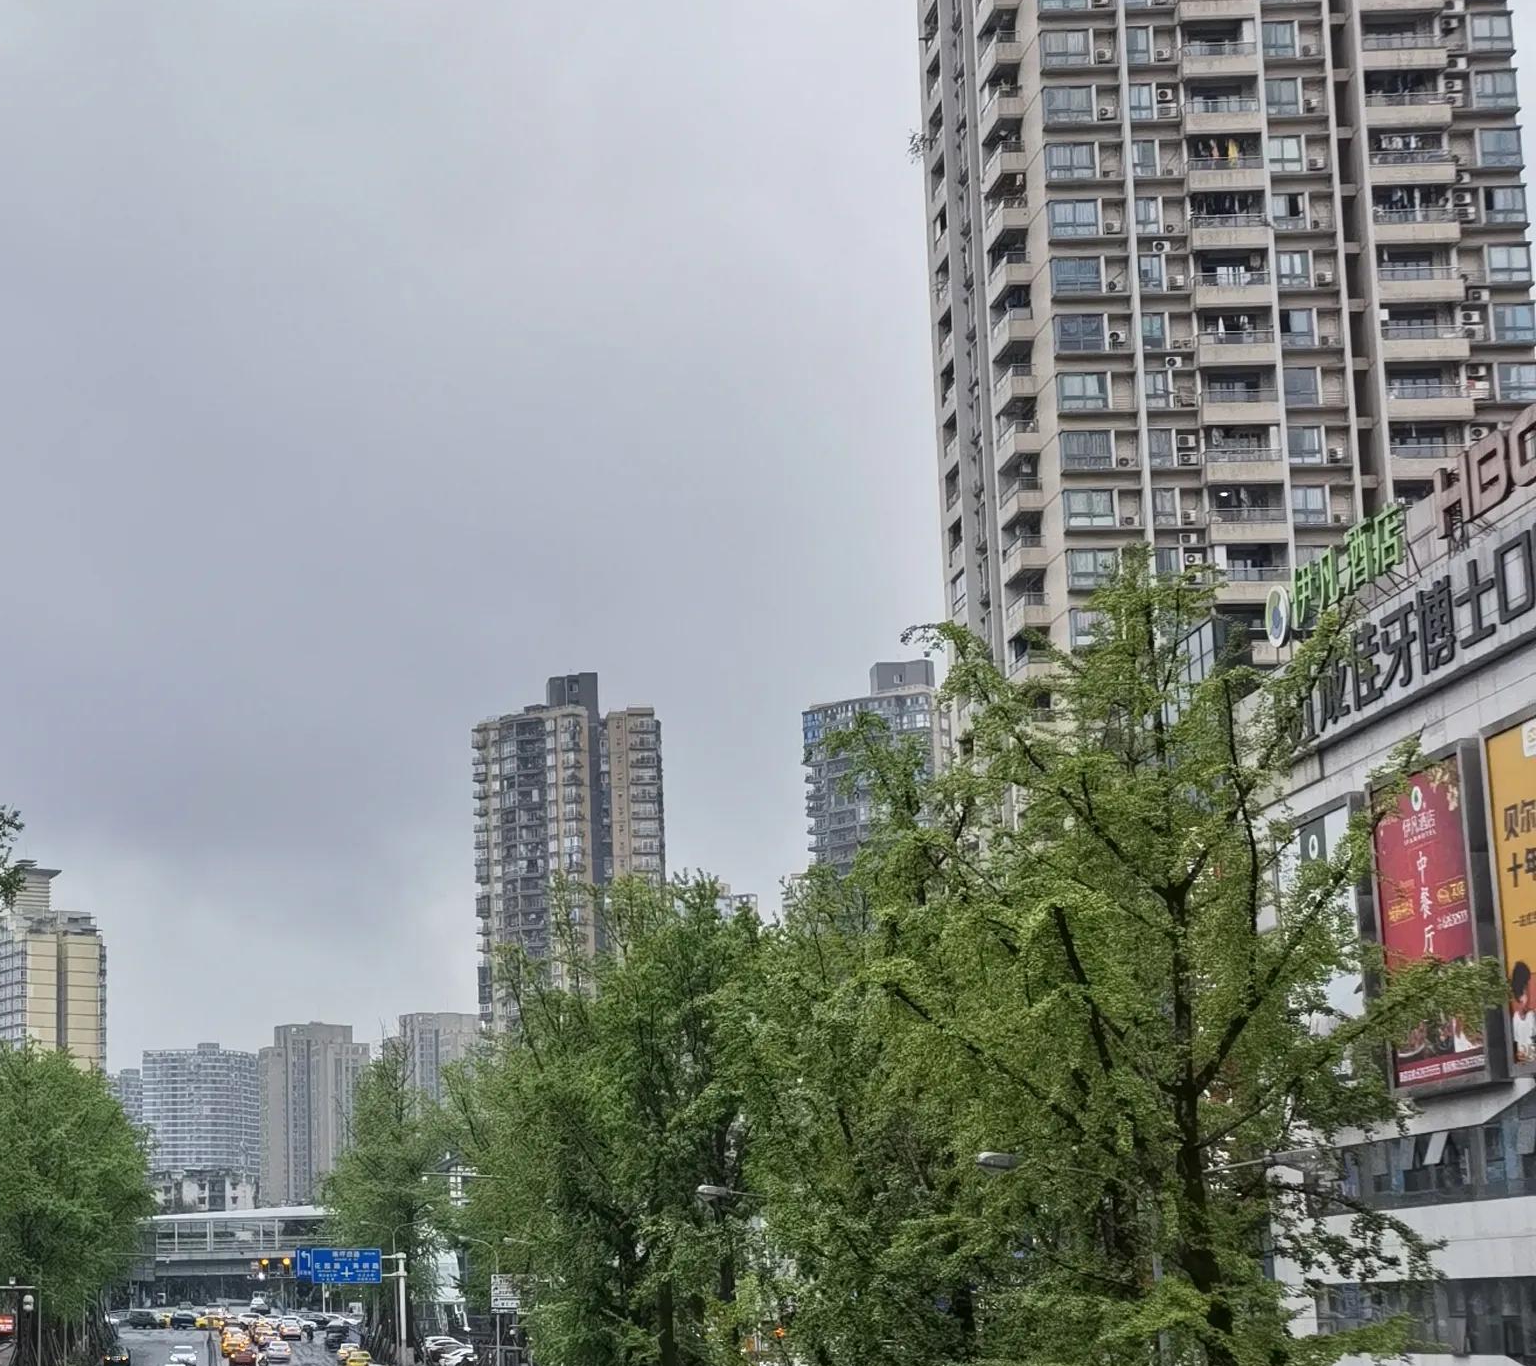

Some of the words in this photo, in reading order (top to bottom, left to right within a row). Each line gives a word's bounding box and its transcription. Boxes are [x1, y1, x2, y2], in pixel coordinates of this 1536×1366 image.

[1291, 502, 1406, 628] 伊凡酒店
[1402, 809, 1436, 839] 伊凡酒店
[1416, 850, 1436, 954] 中餐厅
